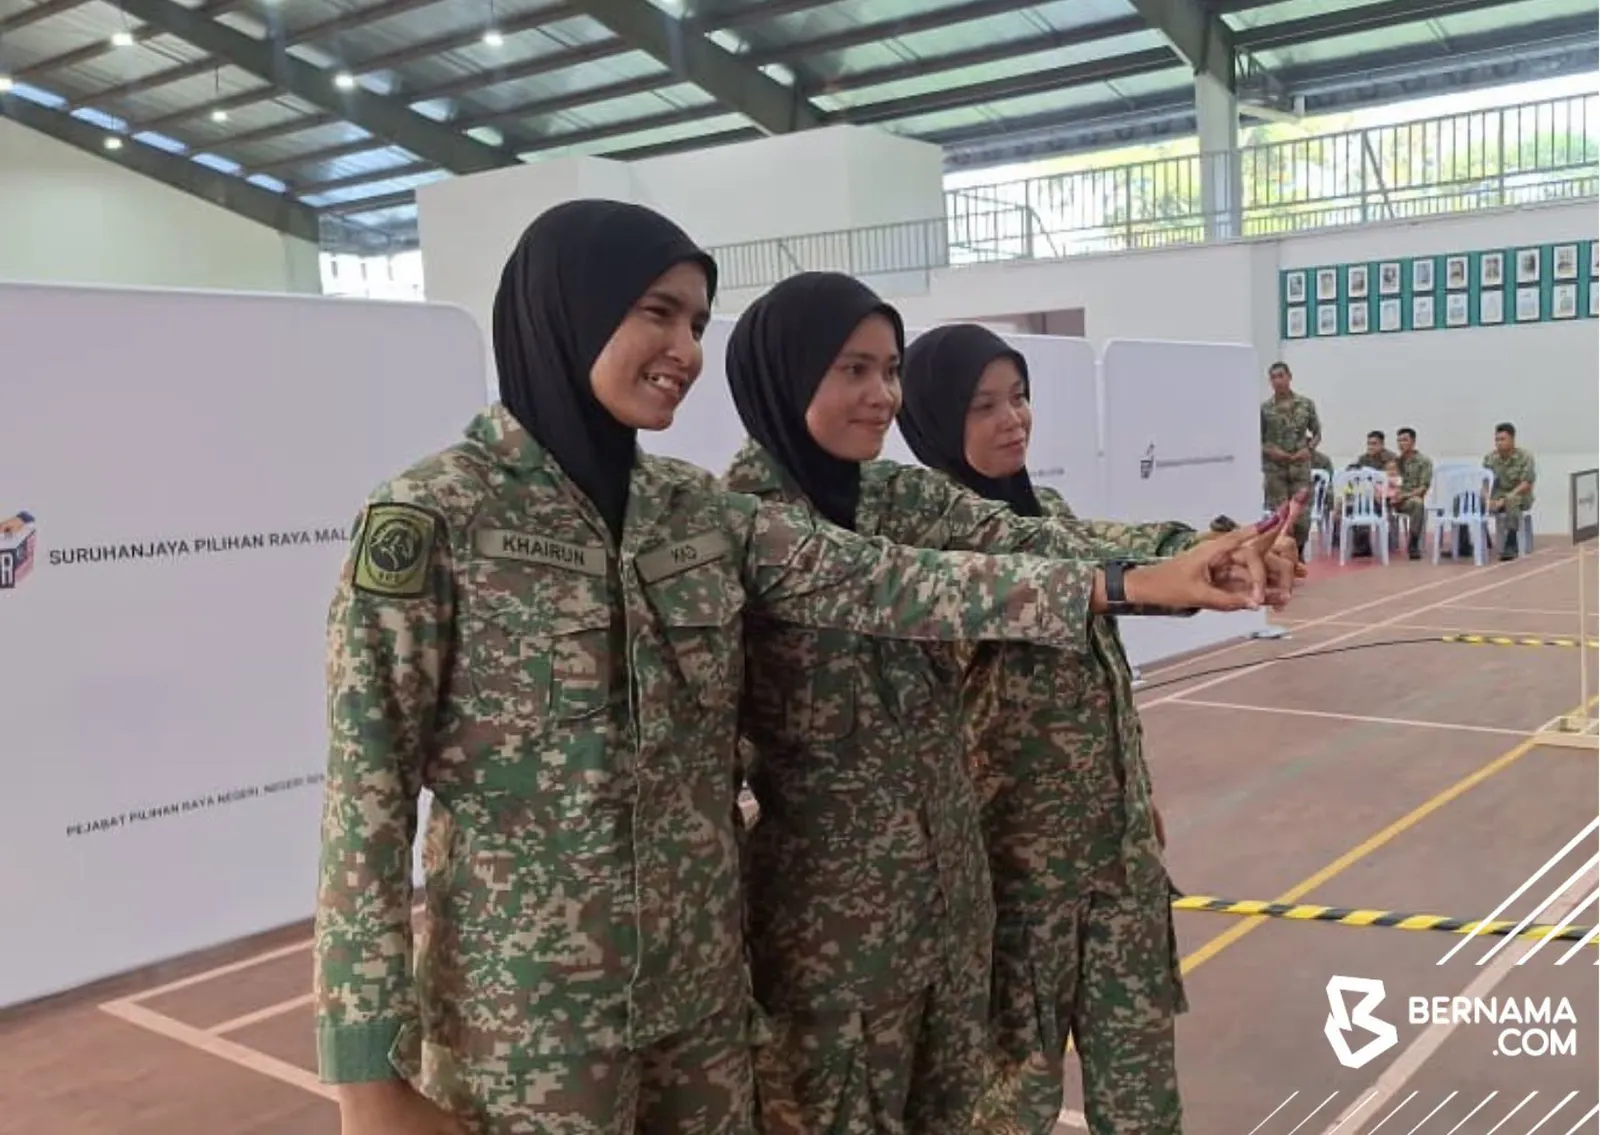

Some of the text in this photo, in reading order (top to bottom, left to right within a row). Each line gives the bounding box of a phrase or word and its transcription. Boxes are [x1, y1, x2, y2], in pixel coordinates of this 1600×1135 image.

[49, 541, 190, 566] SURUHANJAYA
[194, 535, 264, 553] PILIHAN
[269, 530, 310, 546] RAYA
[502, 534, 586, 566] KHAIRUN
[66, 814, 126, 836] PEJABAT
